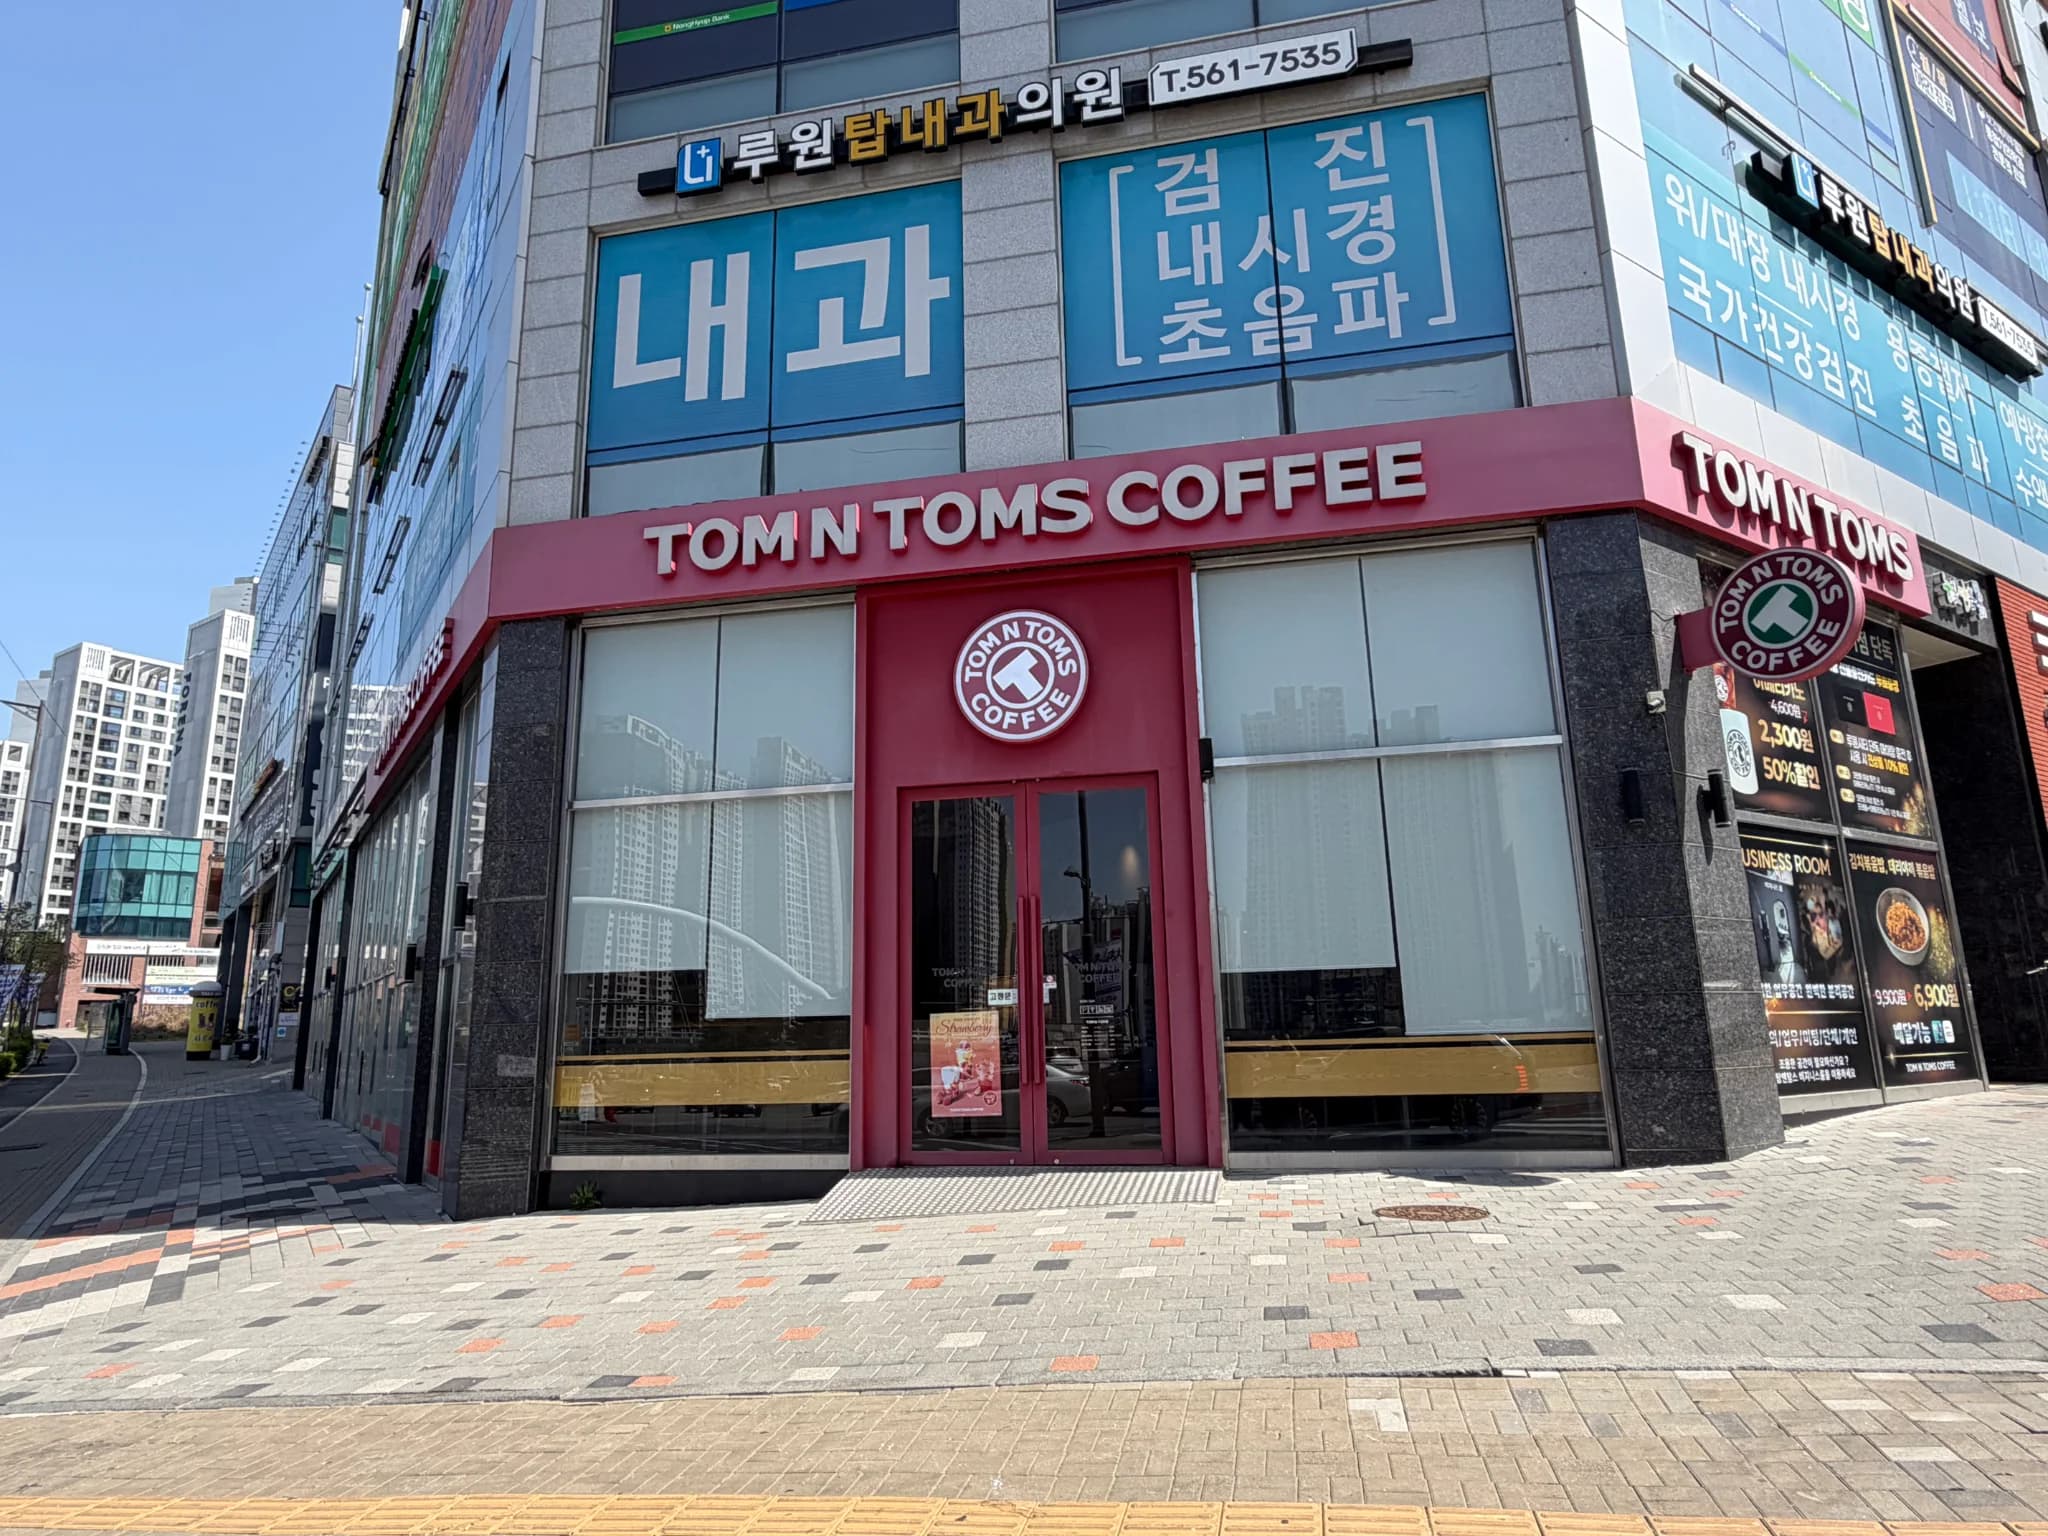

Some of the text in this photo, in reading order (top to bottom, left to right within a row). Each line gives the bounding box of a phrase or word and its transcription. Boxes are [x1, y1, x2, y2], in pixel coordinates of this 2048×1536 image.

[1160, 40, 1342, 94] T.561-7535
[1156, 194, 1398, 287] 내시경
[611, 223, 951, 403] 내과
[1158, 272, 1410, 365] 초음파
[1780, 249, 1862, 342] 내시경
[1900, 394, 1992, 484] 초음파
[643, 440, 1428, 576] TOM N TOMS COFFEE
[1676, 430, 1915, 583] TOM N TOMS
[1719, 556, 1845, 634] TOM N TOMS
[964, 620, 1078, 683] TOM N TOMS
[1731, 617, 1841, 673] COFFEE
[971, 687, 1071, 731] COFFEE
[1757, 718, 1815, 754] 2,300원
[1741, 847, 1832, 876] USINESS ROOM
[1913, 983, 1961, 1012] 6,900원
[1768, 1027, 1859, 1049] 의/업무/미팅/단체/개인
